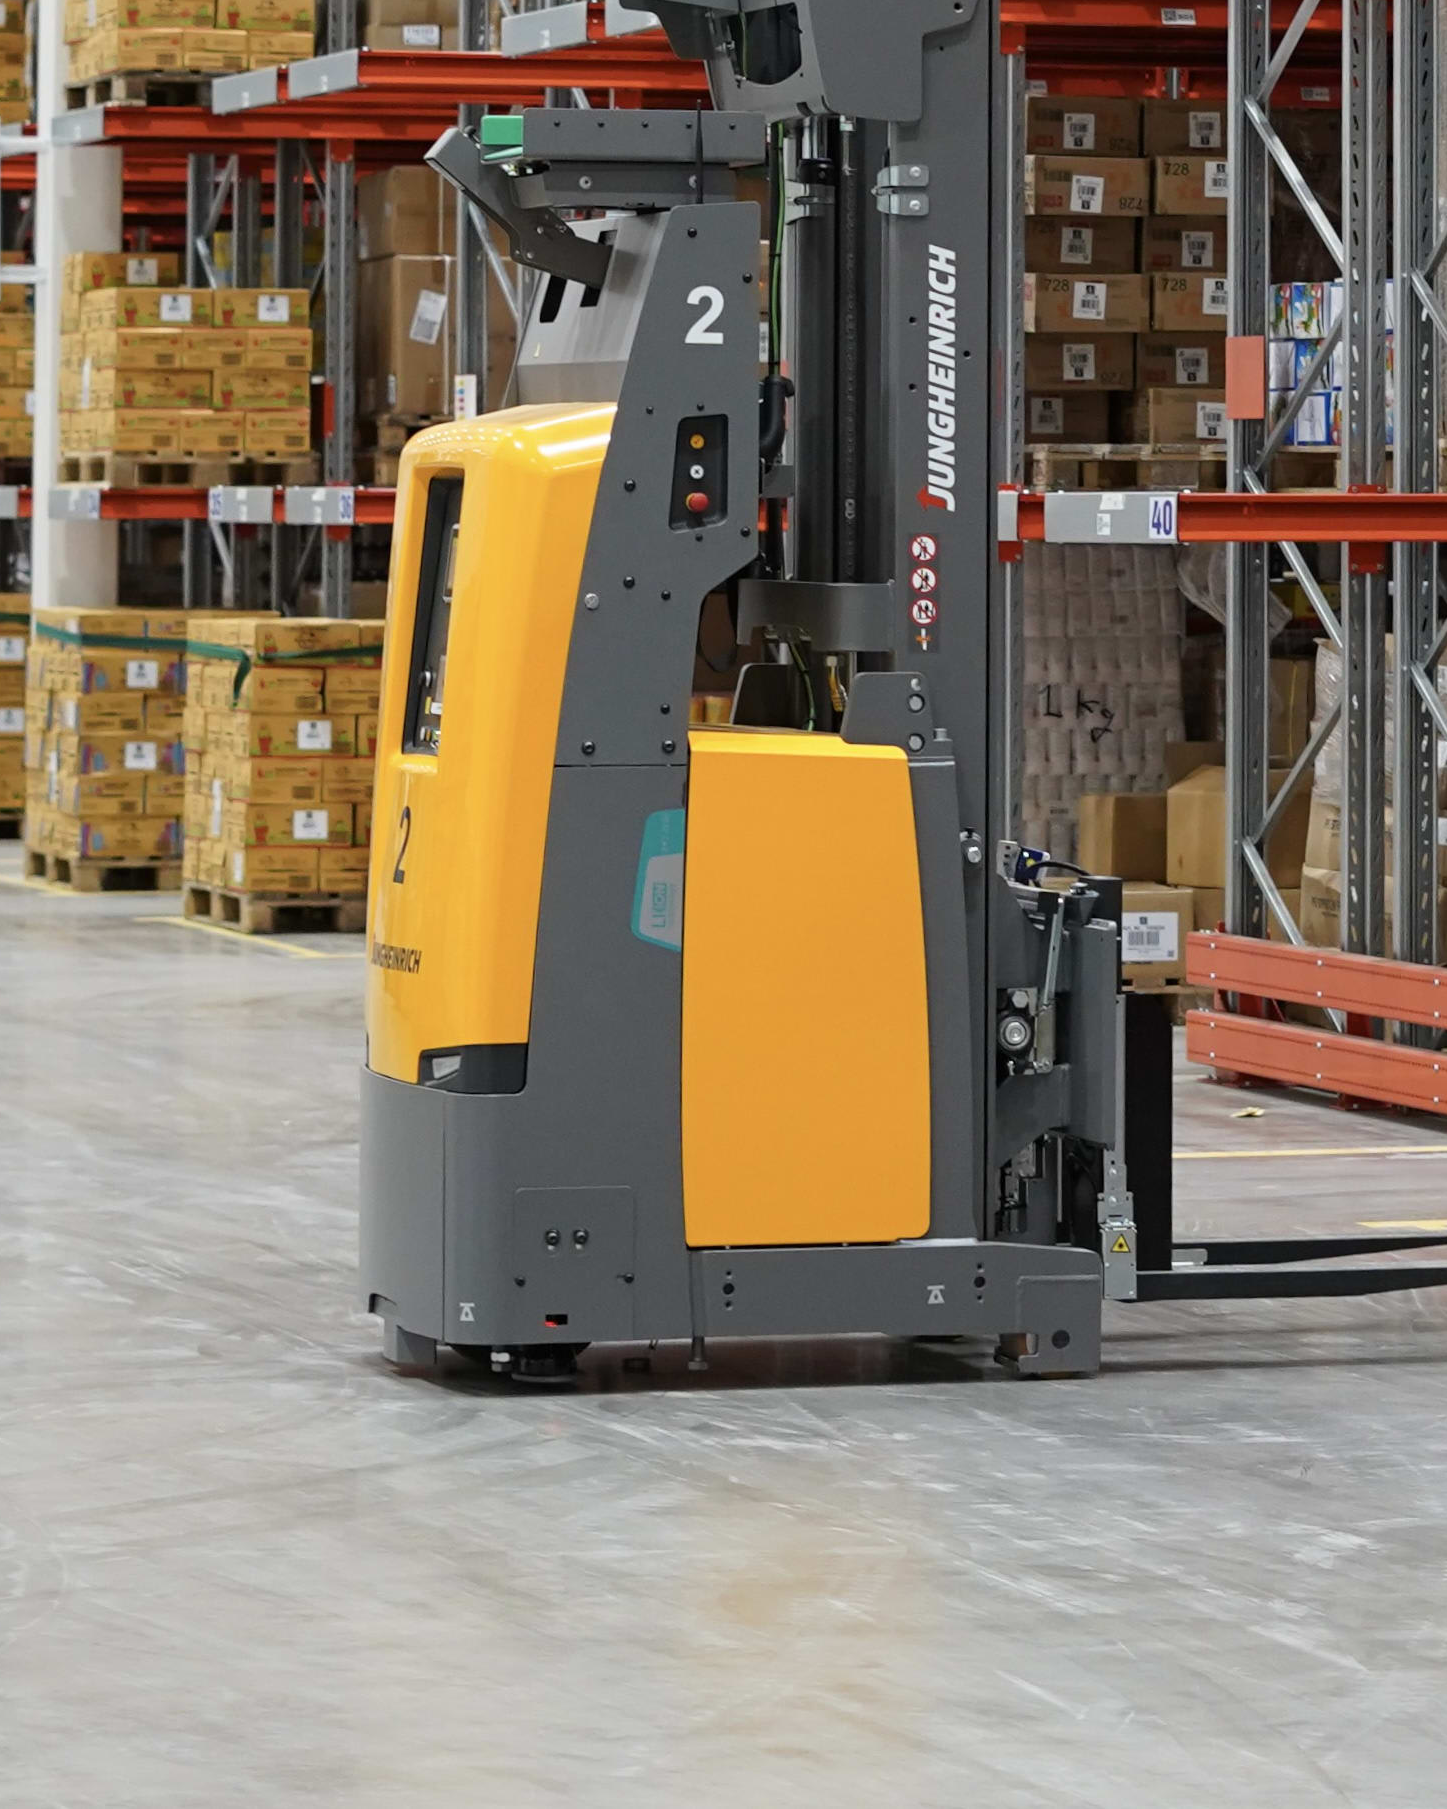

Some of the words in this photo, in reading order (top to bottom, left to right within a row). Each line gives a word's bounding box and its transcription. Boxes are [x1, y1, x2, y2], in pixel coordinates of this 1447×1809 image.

[1164, 163, 1190, 176] 728
[1045, 278, 1070, 292] 728
[1161, 279, 1187, 292] 728
[684, 285, 724, 345] 2
[927, 244, 956, 512] JUNGHEINRICH
[1152, 500, 1172, 536] 40
[392, 805, 411, 884] 2
